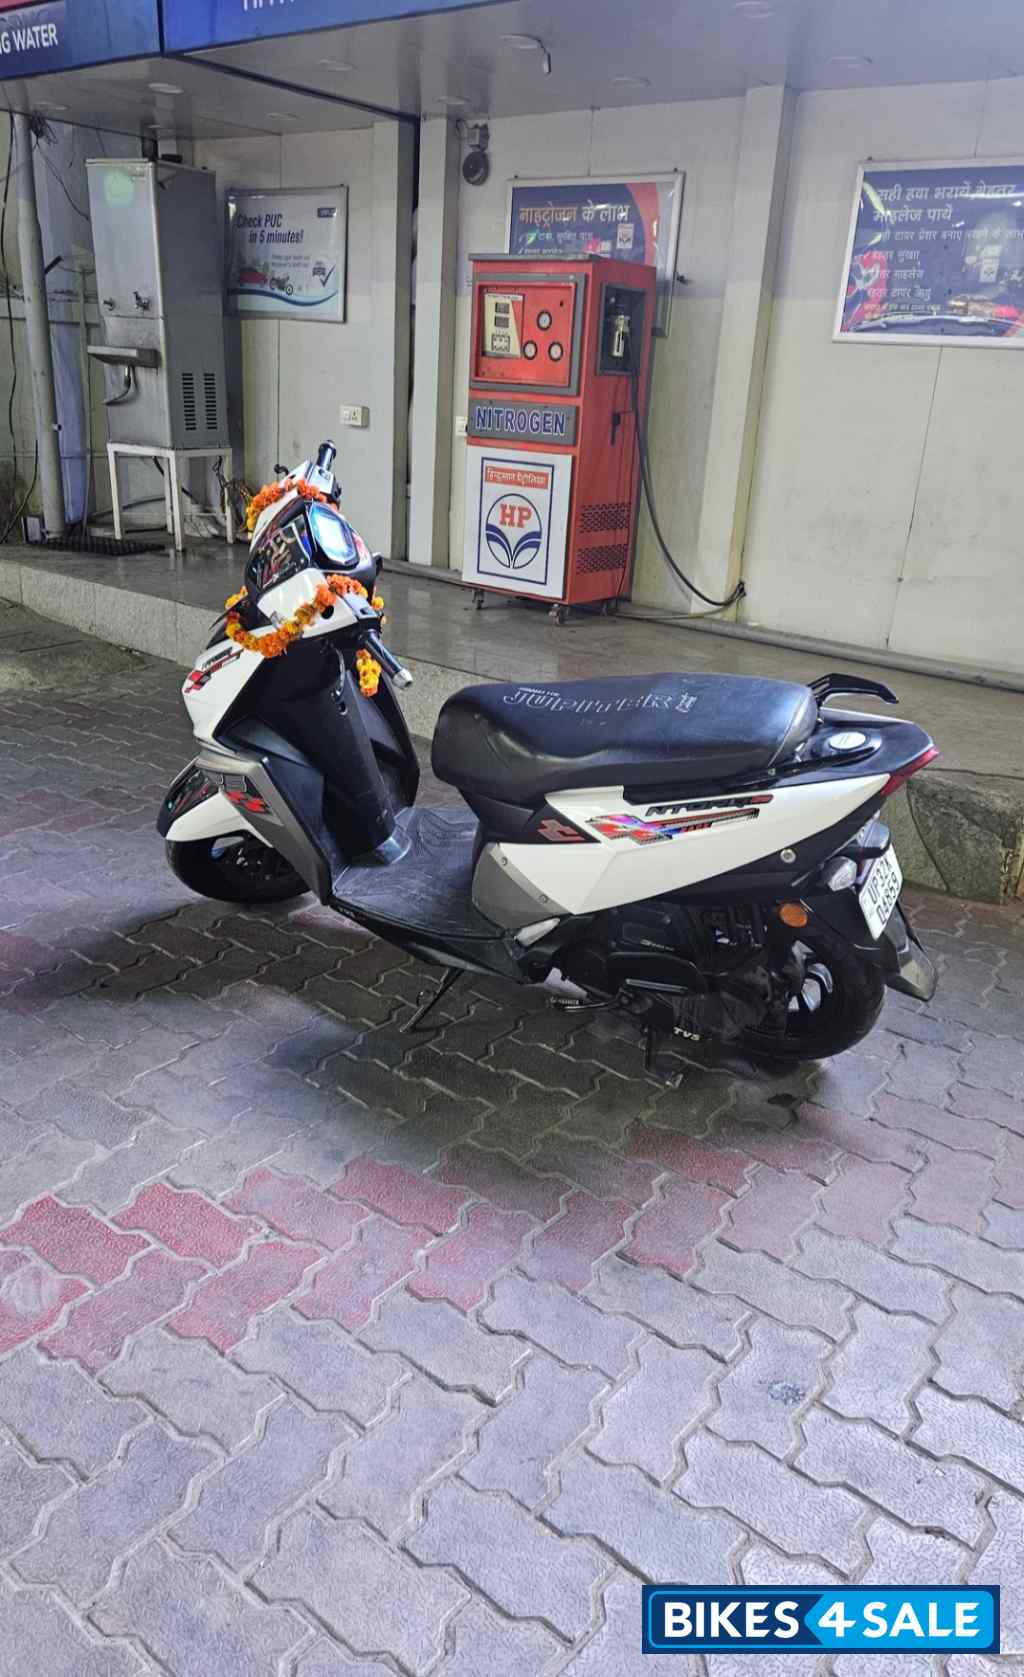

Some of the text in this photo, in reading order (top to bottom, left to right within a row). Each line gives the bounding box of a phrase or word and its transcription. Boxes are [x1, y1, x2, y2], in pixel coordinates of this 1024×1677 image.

[0, 23, 58, 55] G WATER
[237, 213, 283, 228] Check PUC
[475, 406, 566, 436] NITROGEN
[500, 503, 533, 529] HP
[673, 1026, 701, 1041] TVS
